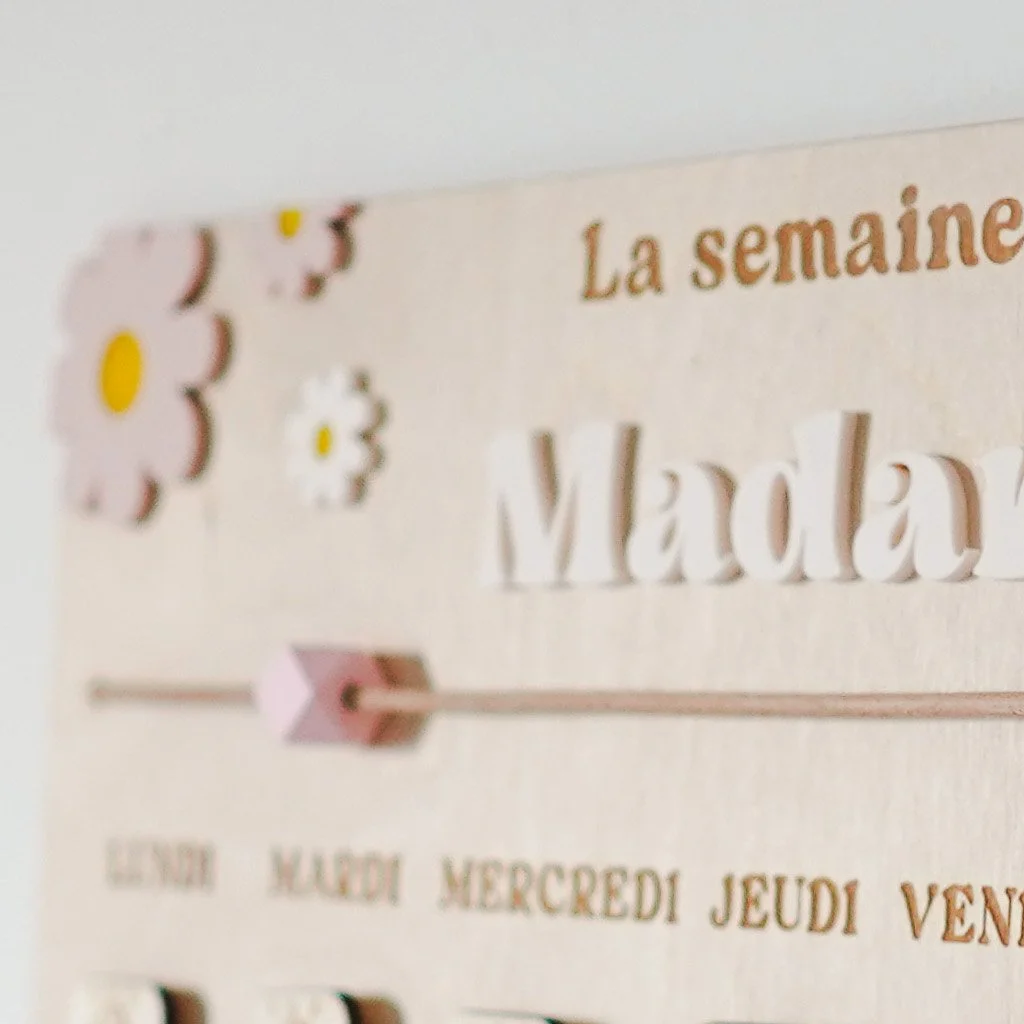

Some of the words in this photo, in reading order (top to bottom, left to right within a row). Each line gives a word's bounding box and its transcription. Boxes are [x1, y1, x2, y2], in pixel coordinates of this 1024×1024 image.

[580, 217, 664, 303] La
[269, 845, 404, 906] MARDI
[438, 857, 682, 924] MERCREDI
[709, 873, 861, 936] JEUDI
